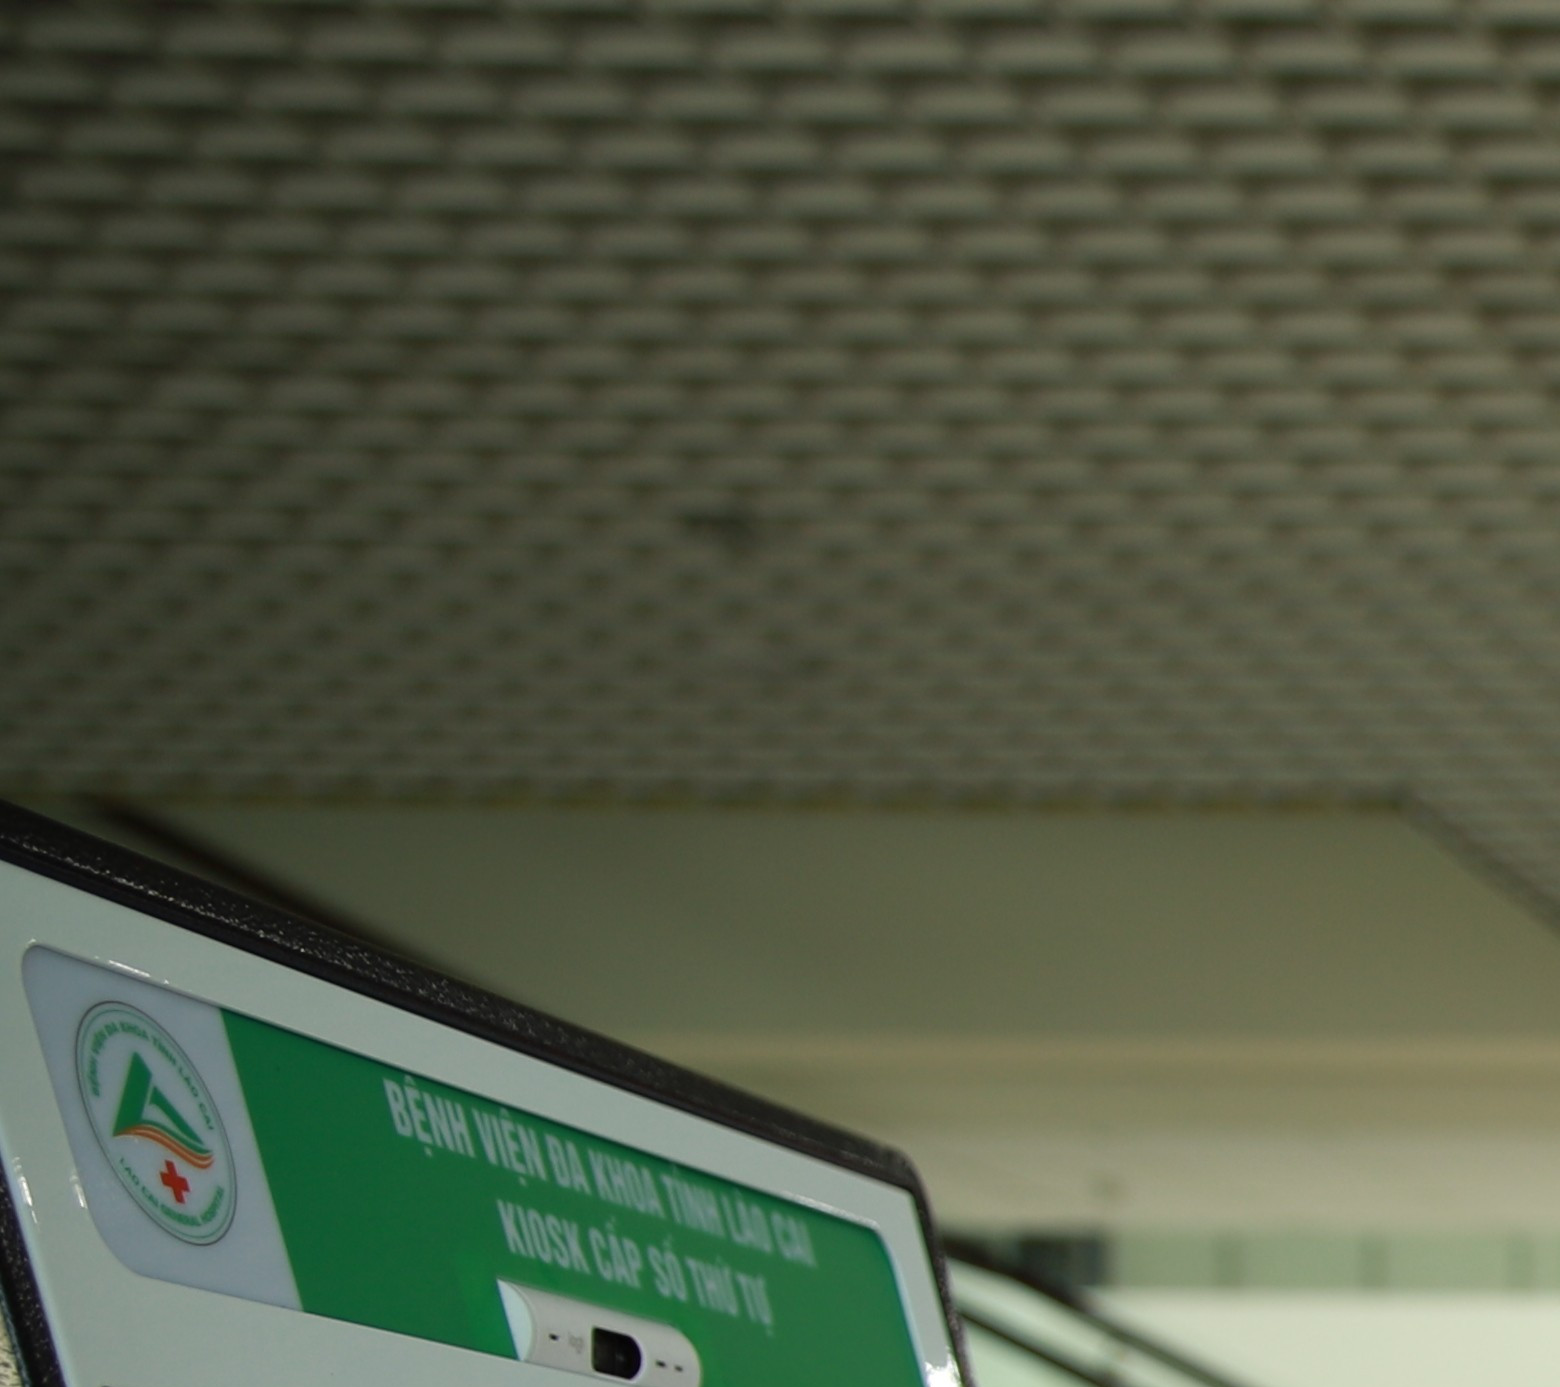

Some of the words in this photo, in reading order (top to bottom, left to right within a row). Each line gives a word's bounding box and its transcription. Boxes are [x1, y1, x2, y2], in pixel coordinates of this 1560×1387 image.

[383, 1074, 476, 1157] BỆNH
[471, 1107, 547, 1187] VIỆN
[544, 1132, 592, 1196] ĐA
[588, 1148, 664, 1218] KHOA
[769, 1210, 817, 1268] CAI
[497, 1199, 590, 1275] KIOSK
[588, 1215, 642, 1289] CẤP
[647, 1234, 688, 1303] SỐ
